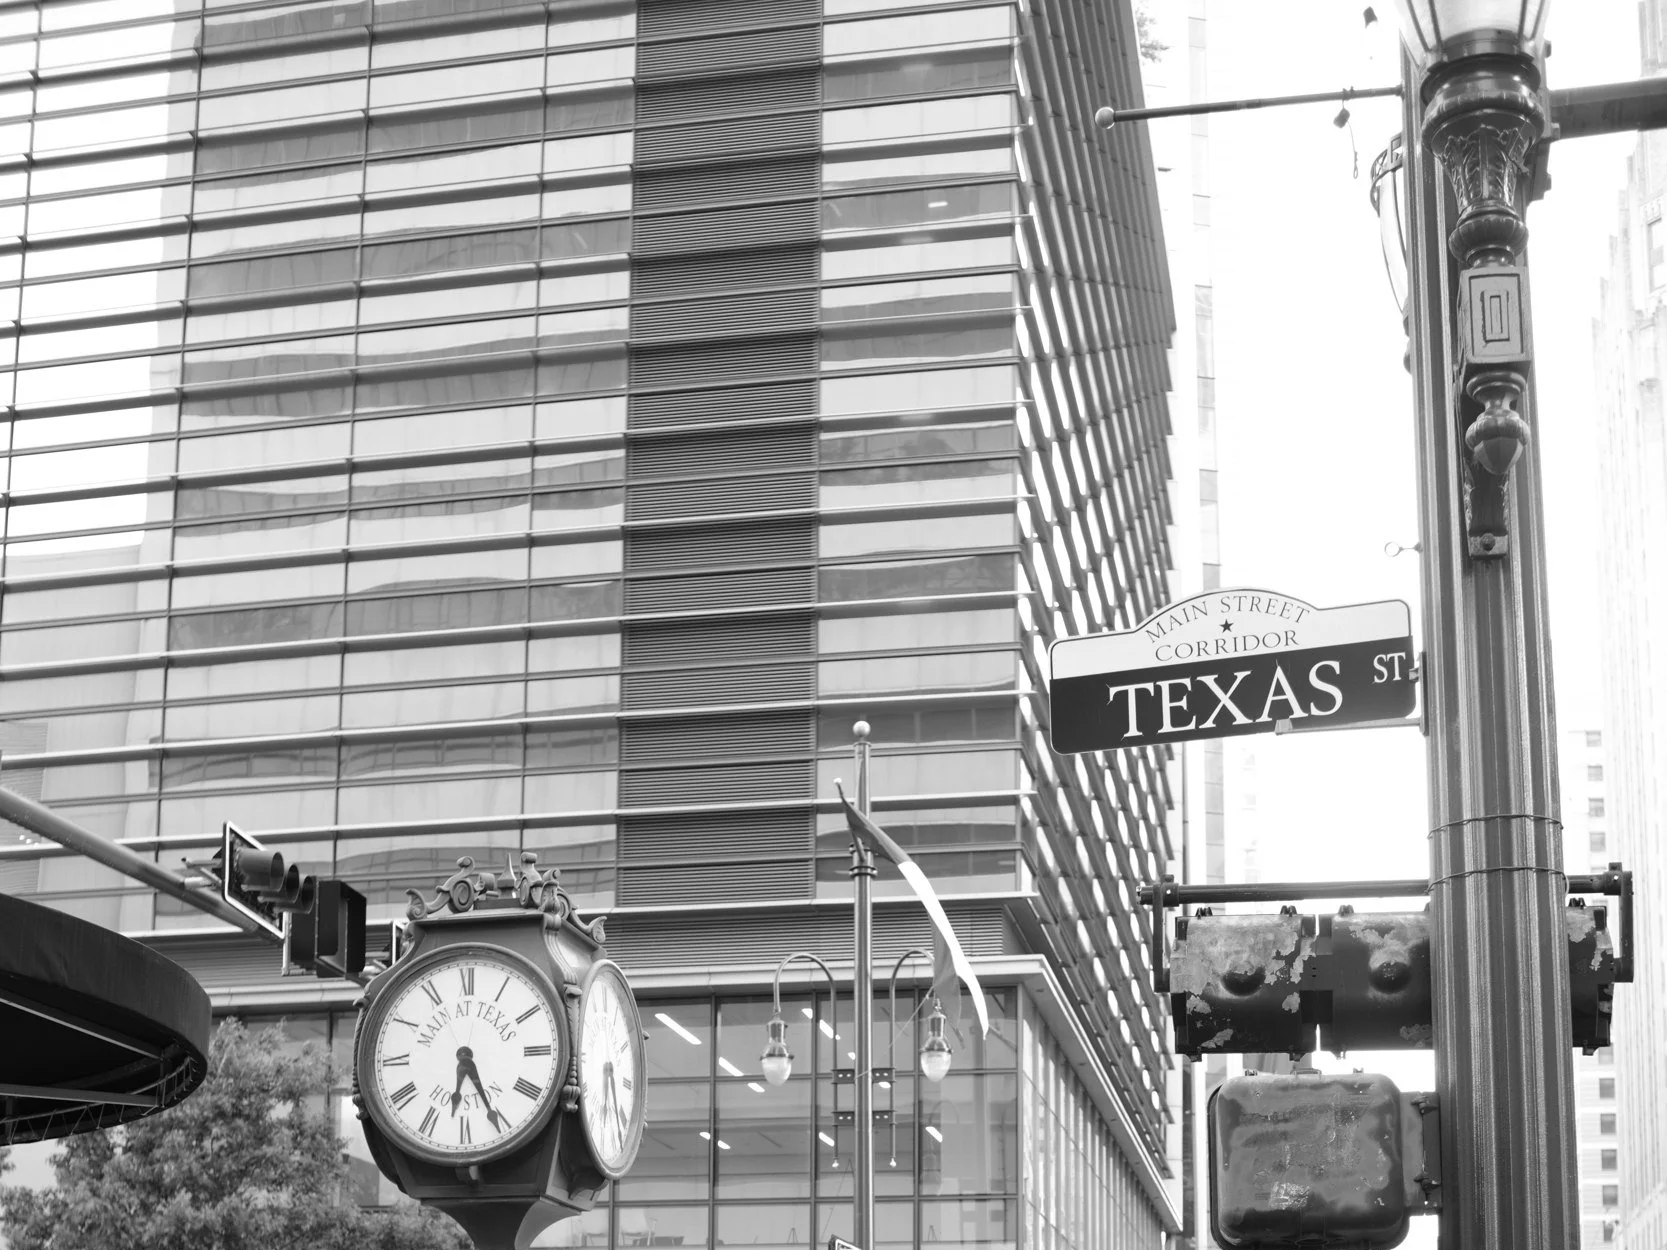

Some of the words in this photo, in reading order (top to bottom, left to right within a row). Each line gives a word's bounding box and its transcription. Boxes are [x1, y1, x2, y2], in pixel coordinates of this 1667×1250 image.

[1145, 600, 1208, 644] MAIN
[1220, 594, 1311, 625] STREET
[1155, 629, 1300, 662] CORRIDOR
[1106, 660, 1343, 740] TEXAS
[1373, 652, 1406, 684] ST
[417, 1006, 452, 1048] MAIN
[456, 1000, 472, 1019] AT
[477, 1001, 517, 1042] TEXAS
